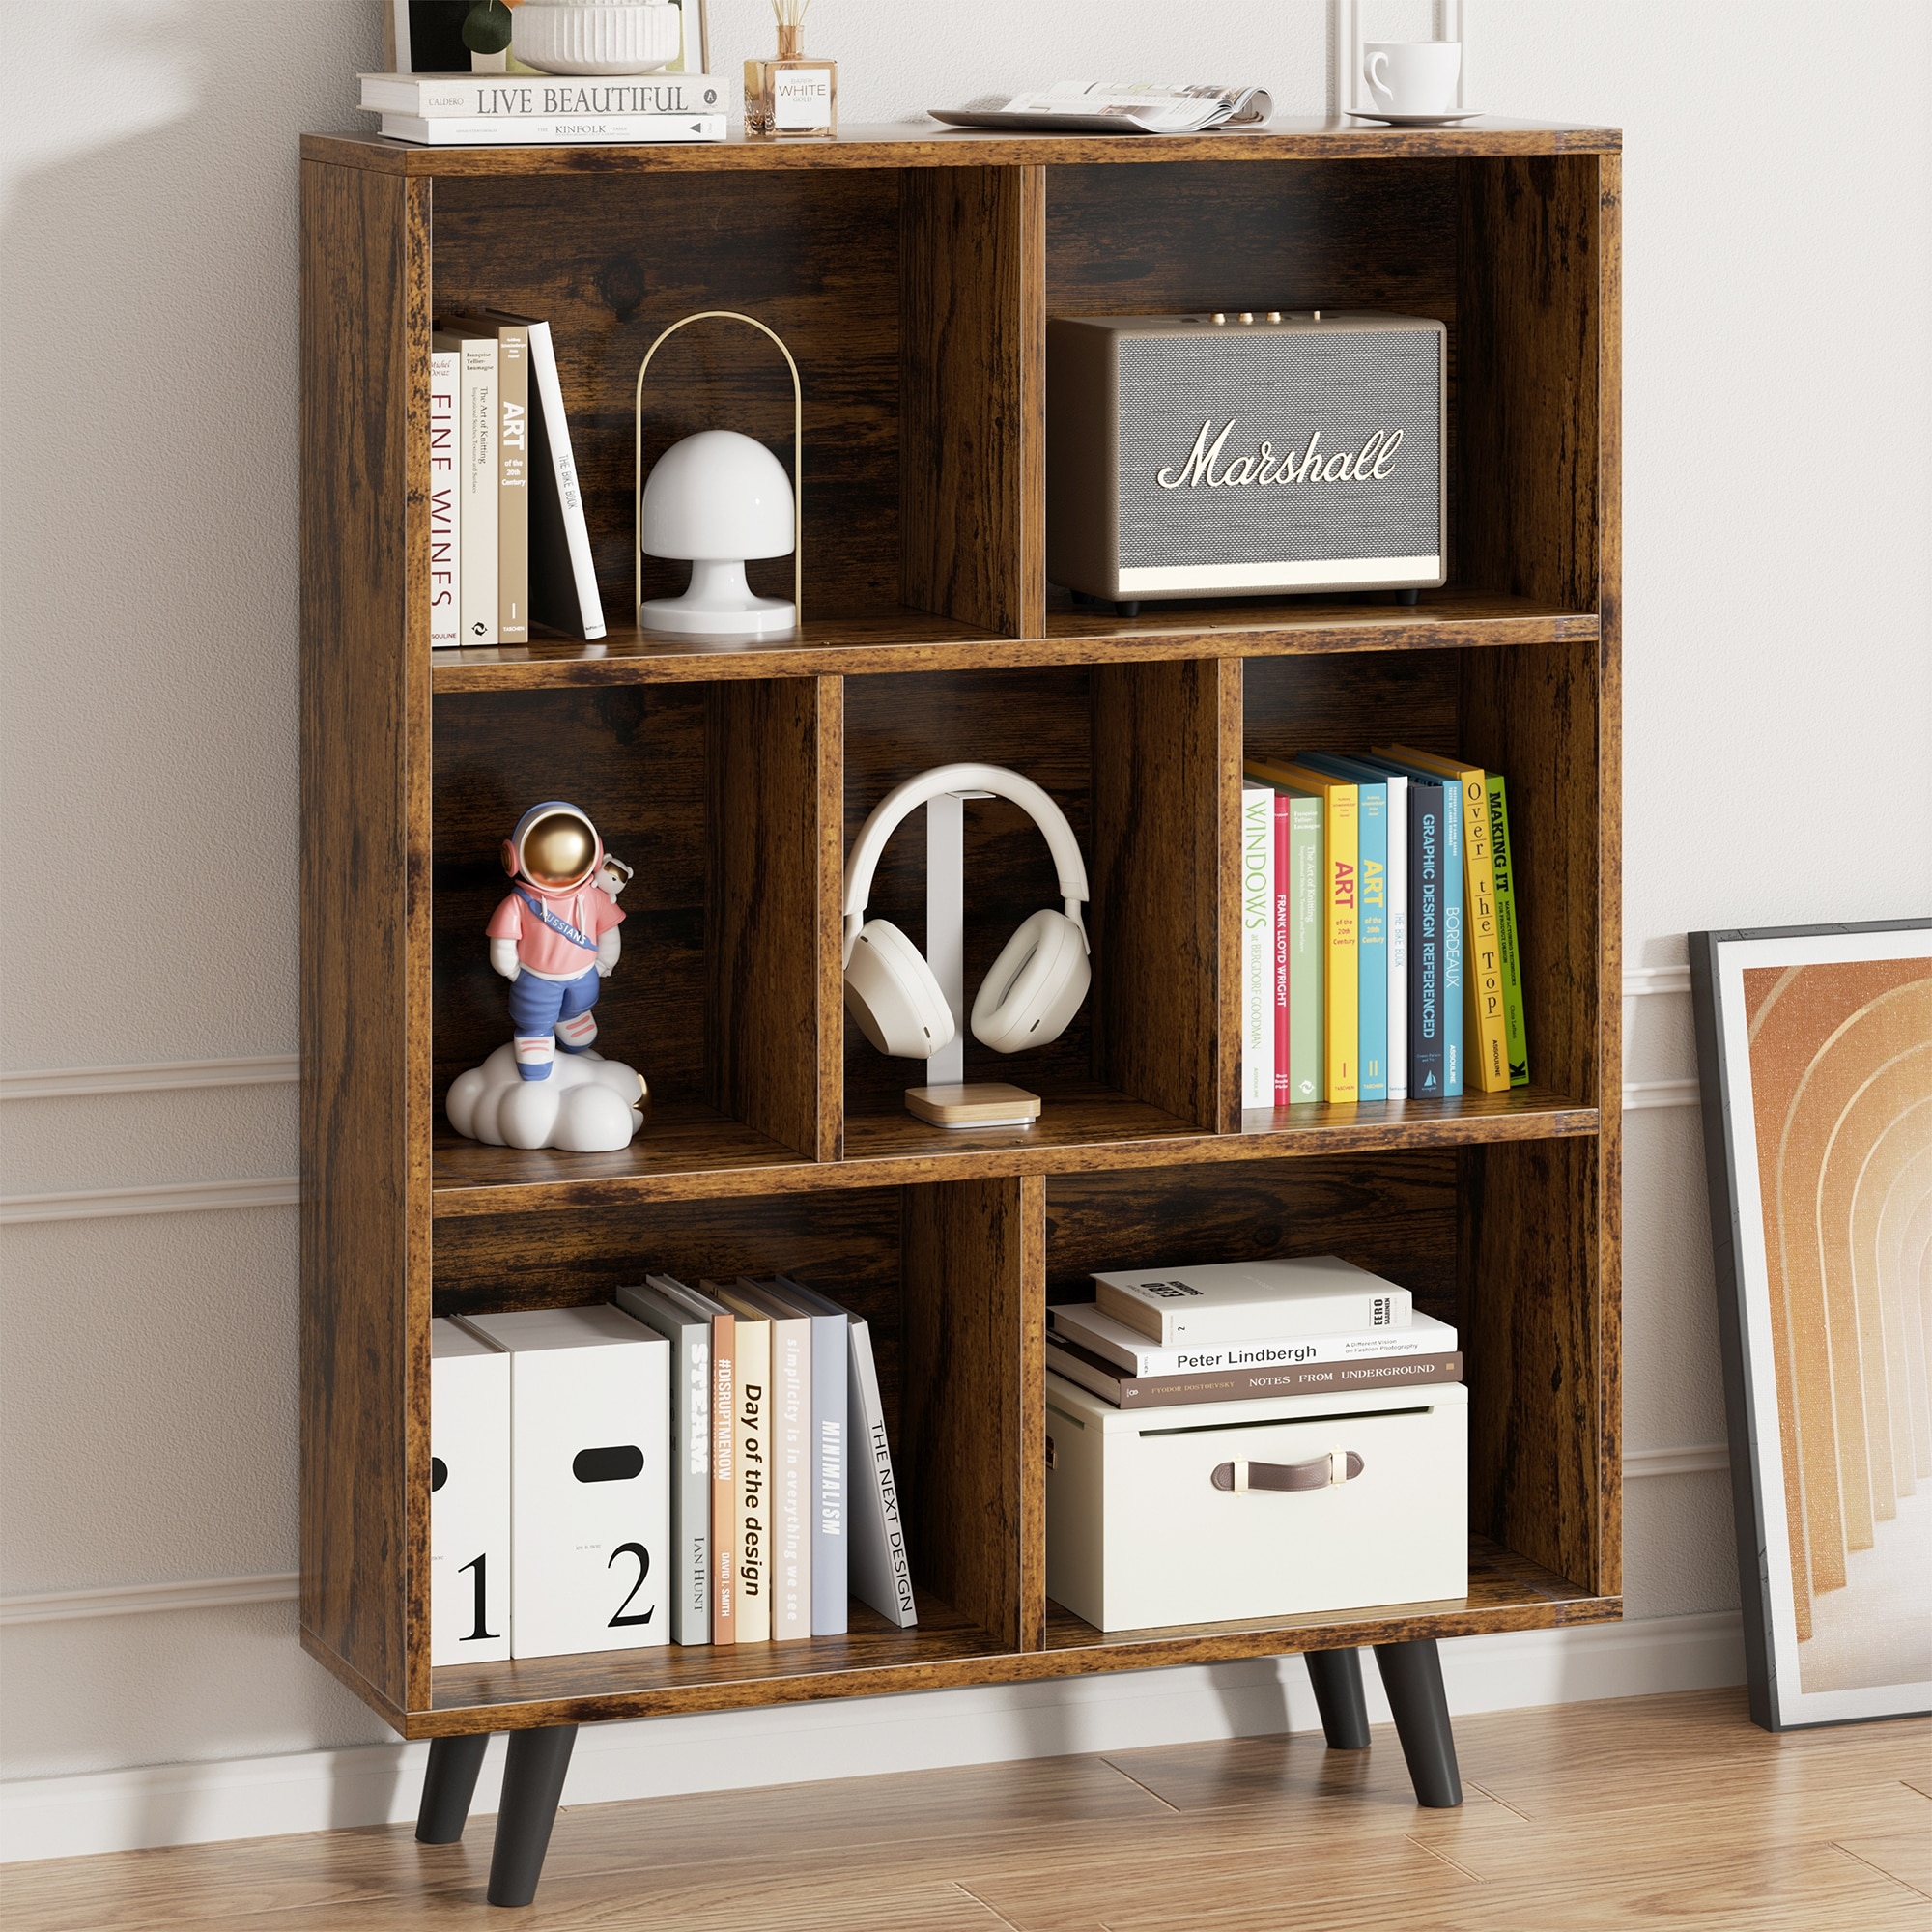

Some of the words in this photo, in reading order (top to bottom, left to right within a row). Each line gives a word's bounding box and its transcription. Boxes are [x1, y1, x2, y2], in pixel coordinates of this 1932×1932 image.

[429, 98, 464, 106] CALDERO
[477, 89, 533, 114] LIVE
[543, 86, 689, 114] BEAUTIFUL
[779, 85, 826, 96] WHITE
[555, 125, 606, 134] KINFOLK
[432, 395, 451, 470] FINE
[480, 419, 488, 429] of
[503, 401, 525, 450] ART
[477, 431, 489, 464] Knitting
[558, 454, 570, 469] THE
[1157, 419, 1405, 489] Marshall
[562, 471, 574, 489] BIKE
[564, 491, 578, 510] BOOK
[432, 489, 452, 606] WINES
[1468, 782, 1484, 856] Over
[1490, 791, 1507, 868] MAKING
[1245, 800, 1267, 929] WINDOWS
[1307, 845, 1316, 860] The
[1422, 813, 1435, 880] GRAPHIC
[1307, 864, 1316, 877] Art
[1335, 862, 1354, 909] ART
[1364, 860, 1383, 908] ART
[1495, 872, 1509, 893] IT
[1277, 895, 1287, 929] FRANK
[1305, 889, 1316, 923] Knitting
[1395, 912, 1405, 925] THE
[1422, 885, 1435, 937] DESIGN
[1480, 880, 1490, 931] the
[540, 912, 586, 945] USSIANS
[1252, 933, 1261, 943] at
[1362, 936, 1385, 945] Century
[1395, 929, 1405, 945] BIKE
[1505, 900, 1514, 951] MANUFACTURING
[1277, 930, 1287, 964] LLOYD
[1395, 949, 1405, 968] BOOK
[1446, 907, 1460, 988] BORDEAUX
[1252, 944, 1262, 995] BERGDORF
[1277, 965, 1287, 1007] WRIGHT
[1482, 952, 1497, 1014] Top
[1422, 943, 1435, 1038] REFERENCED
[1252, 997, 1262, 1049] GOODMAN
[1492, 1039, 1501, 1078] ASSOULINE
[1140, 1283, 1185, 1298] EERO
[1374, 1298, 1383, 1325] EERO
[1177, 1354, 1223, 1368] Peter
[1228, 1345, 1318, 1365] Lindbergh
[784, 1339, 799, 1422] simplicity
[1151, 1385, 1182, 1394] FYODOR
[1184, 1380, 1235, 1391] DOSTOEVSKY
[1248, 1376, 1291, 1387] NOTES
[1298, 1370, 1333, 1383] FROM
[1341, 1364, 1435, 1379] UNDERGROUND
[691, 1343, 708, 1474] STEAM
[718, 1358, 732, 1481] #DISRUPTMENOW
[741, 1383, 761, 1430] Day
[745, 1437, 762, 1463] of
[787, 1429, 799, 1443] is
[871, 1420, 889, 1463] THE
[787, 1448, 799, 1464] in
[745, 1469, 762, 1509] the
[821, 1420, 840, 1536] MINIMALISM
[878, 1469, 899, 1525] NEXT
[784, 1470, 799, 1559] everything
[694, 1537, 705, 1565] IAN
[721, 1551, 730, 1579] DAVID
[741, 1517, 762, 1597] design
[607, 1542, 655, 1629] 2
[694, 1569, 705, 1613] HUNT
[787, 1565, 797, 1587] we
[889, 1533, 912, 1613] DESIGN
[458, 1552, 500, 1641] 1
[721, 1588, 730, 1617] SMITH
[787, 1593, 797, 1621] see
